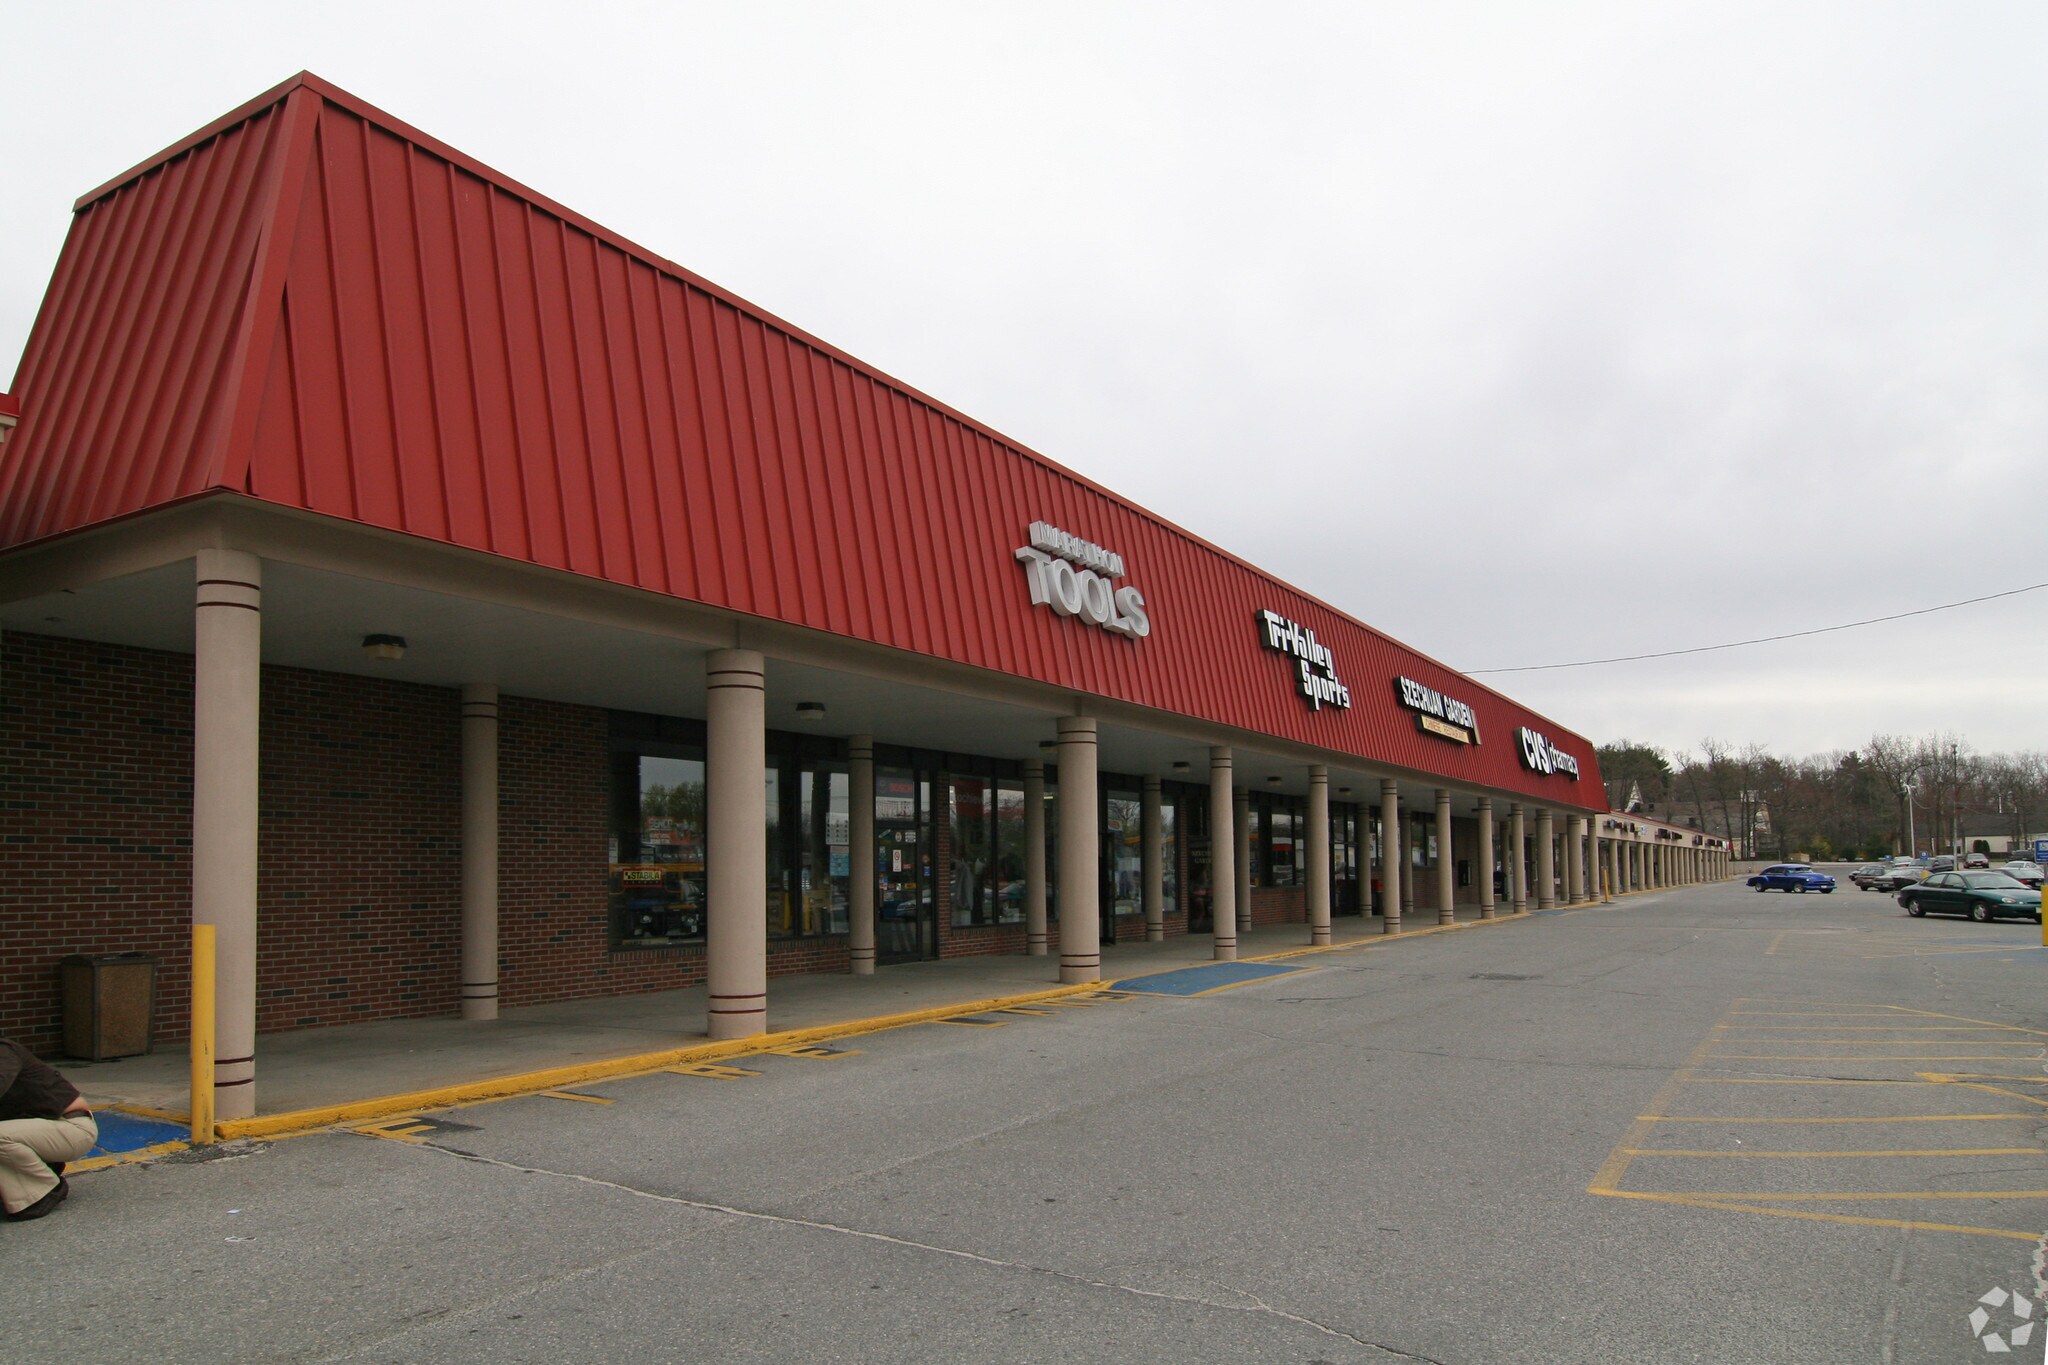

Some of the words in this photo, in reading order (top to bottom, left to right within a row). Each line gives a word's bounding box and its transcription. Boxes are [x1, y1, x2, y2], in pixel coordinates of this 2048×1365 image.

[1015, 546, 1150, 639] TOOLS
[1300, 659, 1351, 711] Sports
[1399, 675, 1445, 718] SZECHUAN
[1443, 695, 1474, 729] GARDEN
[630, 871, 660, 880] STABILA
